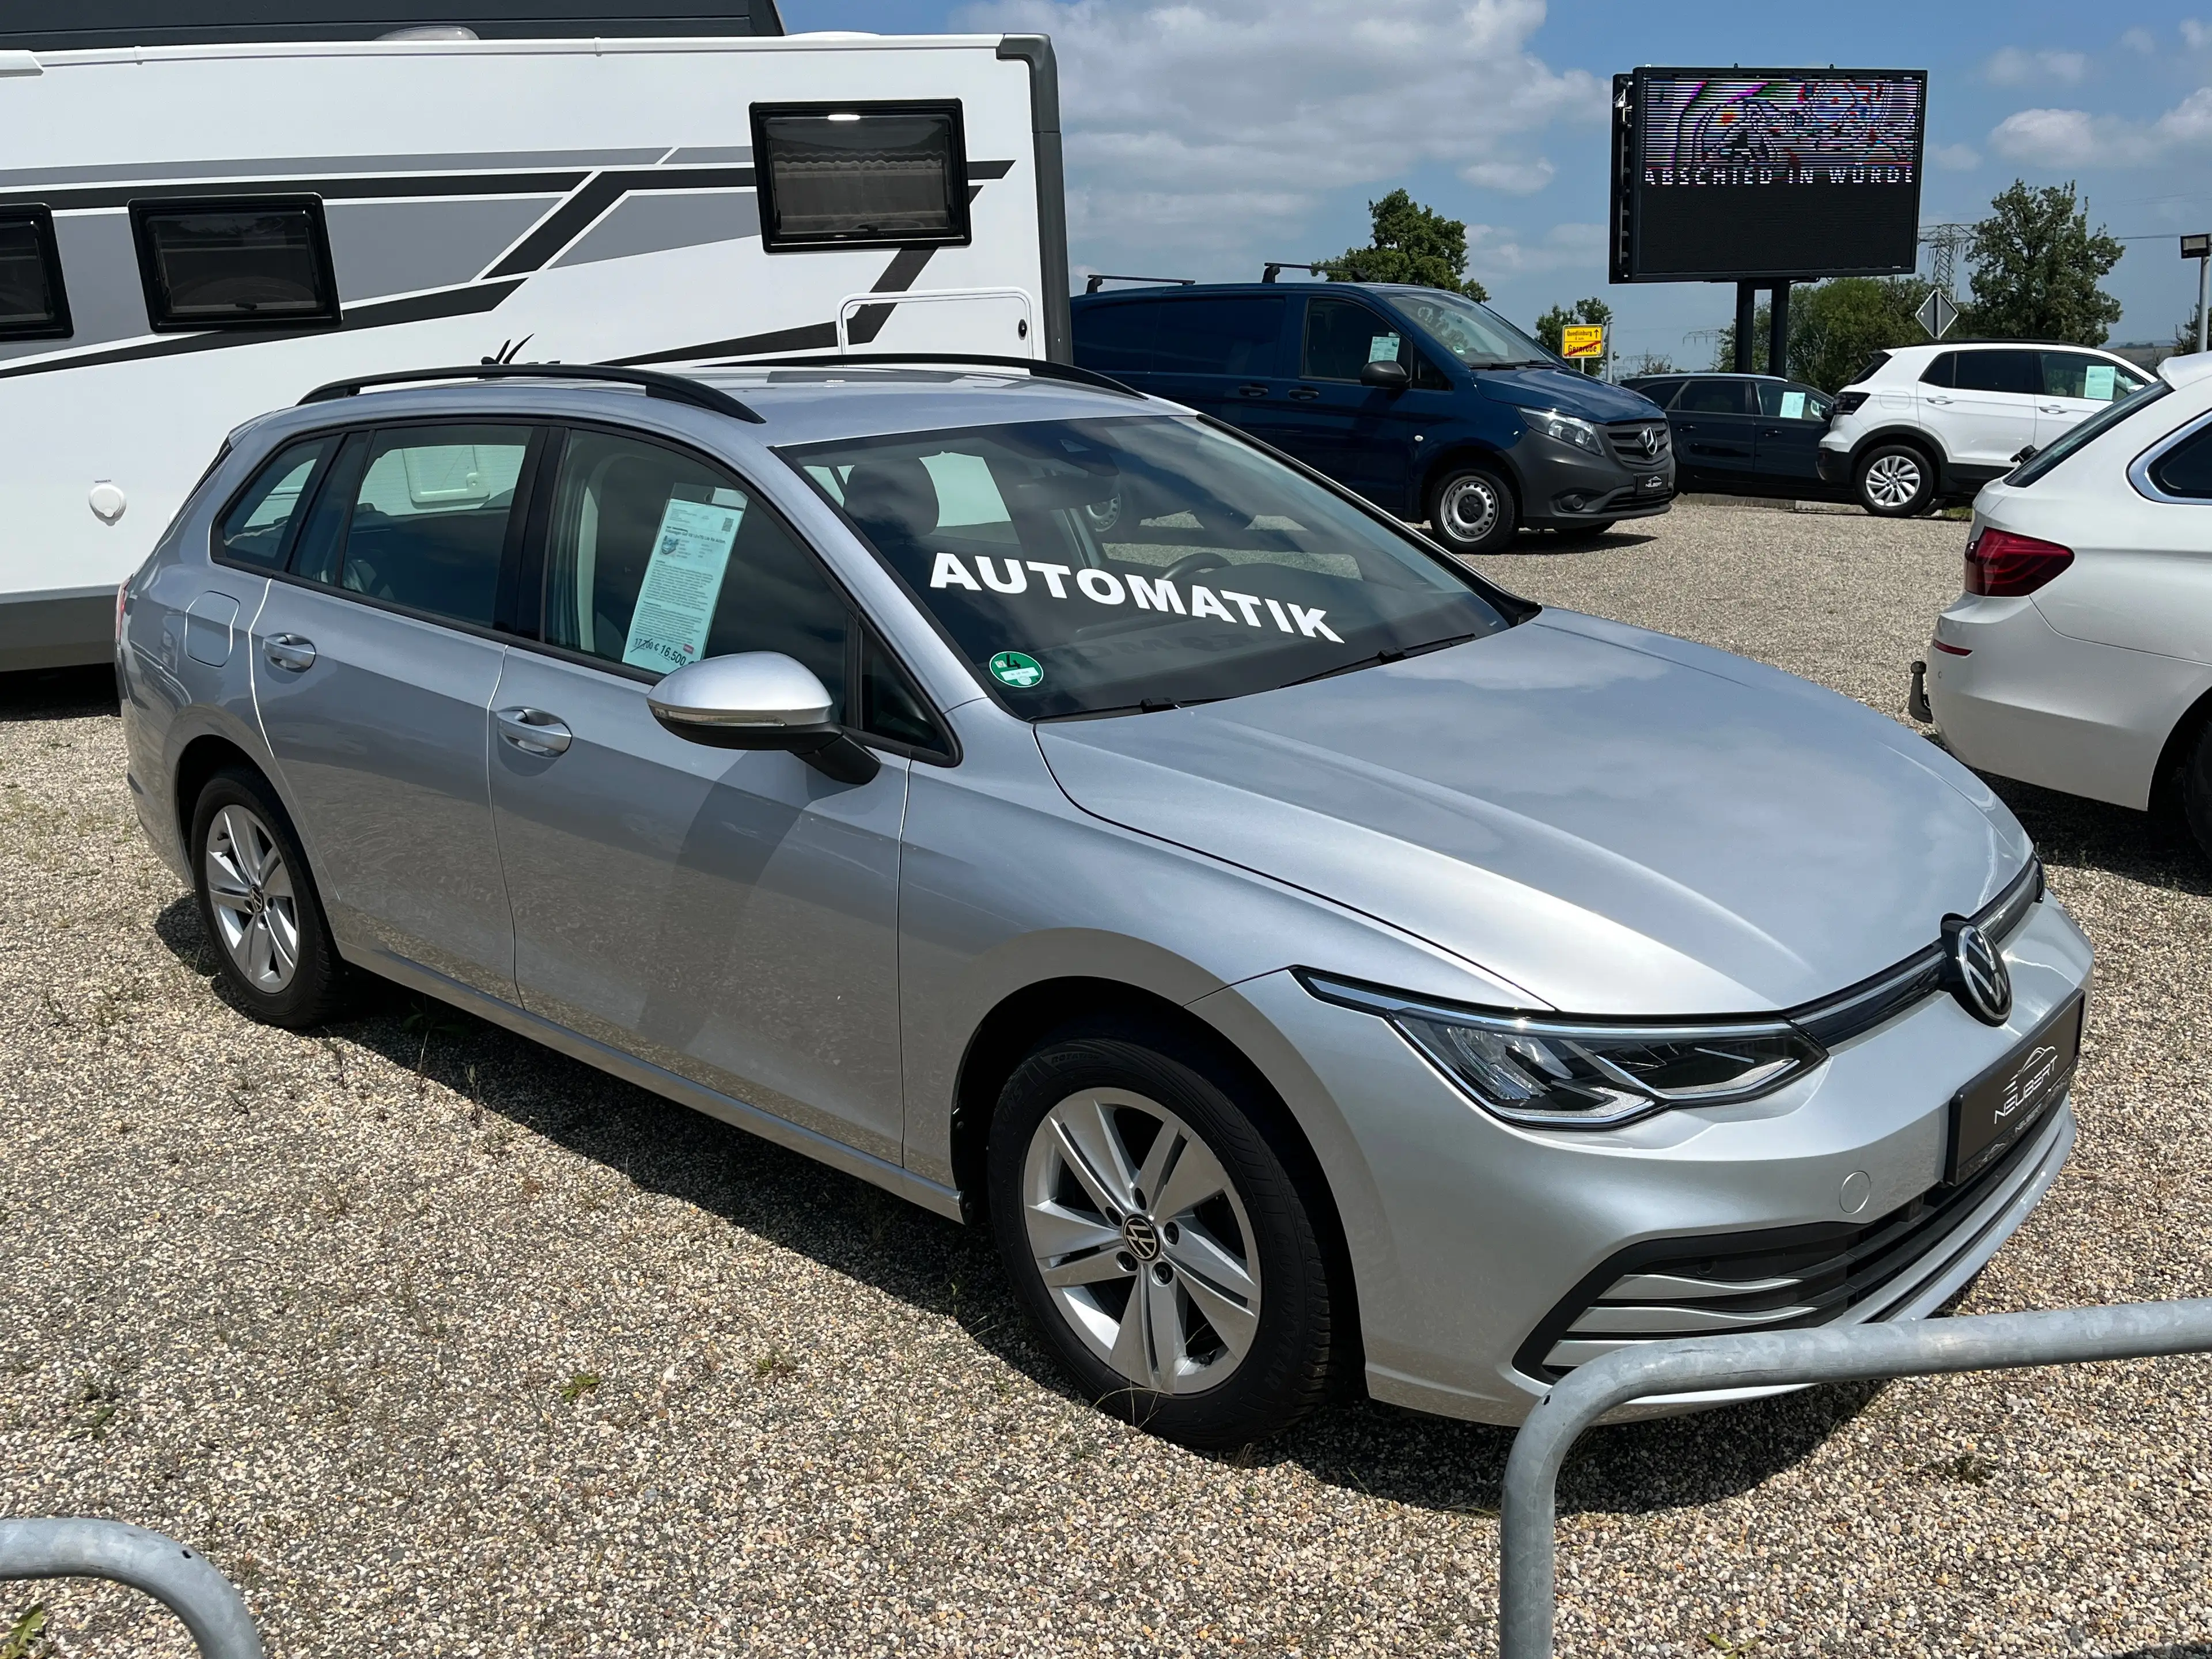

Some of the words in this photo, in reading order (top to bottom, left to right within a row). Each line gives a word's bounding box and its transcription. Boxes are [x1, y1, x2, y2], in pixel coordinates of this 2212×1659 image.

[1644, 167, 1773, 185] ABSCHIED
[1788, 168, 1814, 184] IN
[1568, 344, 1597, 353] Gernrode
[929, 552, 1346, 644] AUTOMATIK
[654, 643, 660, 652] €
[660, 644, 687, 666] 16.500
[1006, 653, 1021, 669] 4
[1994, 1054, 2058, 1125] NEUBERT
